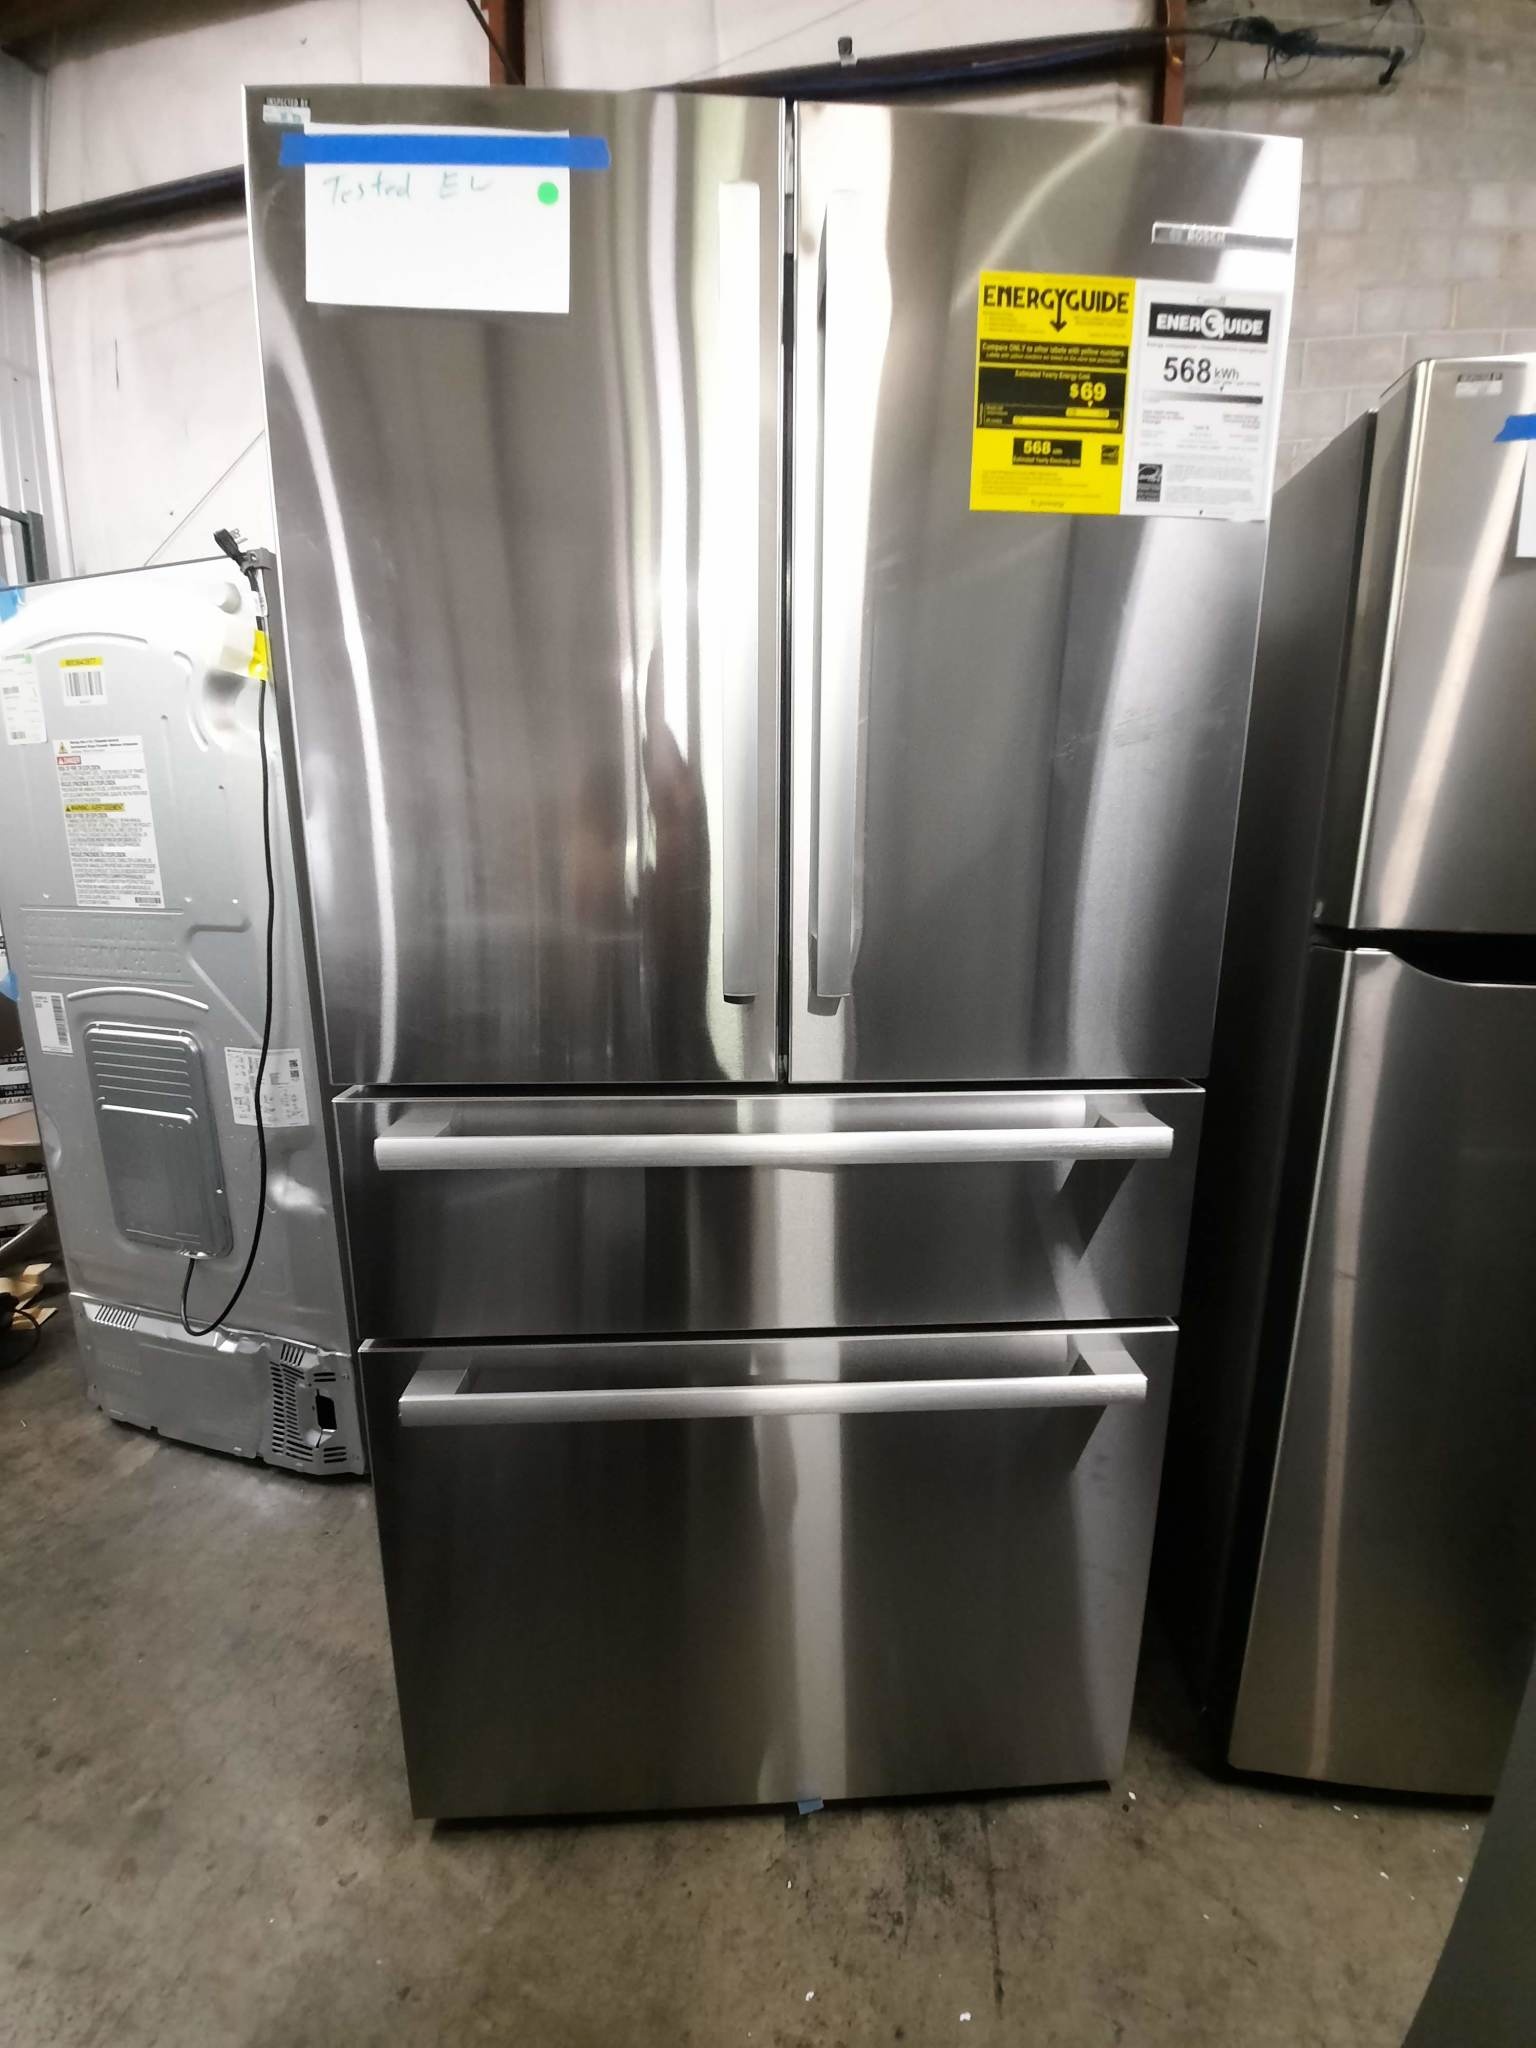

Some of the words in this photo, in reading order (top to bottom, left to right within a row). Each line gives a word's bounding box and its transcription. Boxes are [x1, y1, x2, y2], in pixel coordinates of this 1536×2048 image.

[983, 285, 1130, 315] ENERGYGUIDE
[1163, 357, 1211, 384] 568
[1214, 368, 1240, 381] kWh
[1069, 381, 1107, 402] $69
